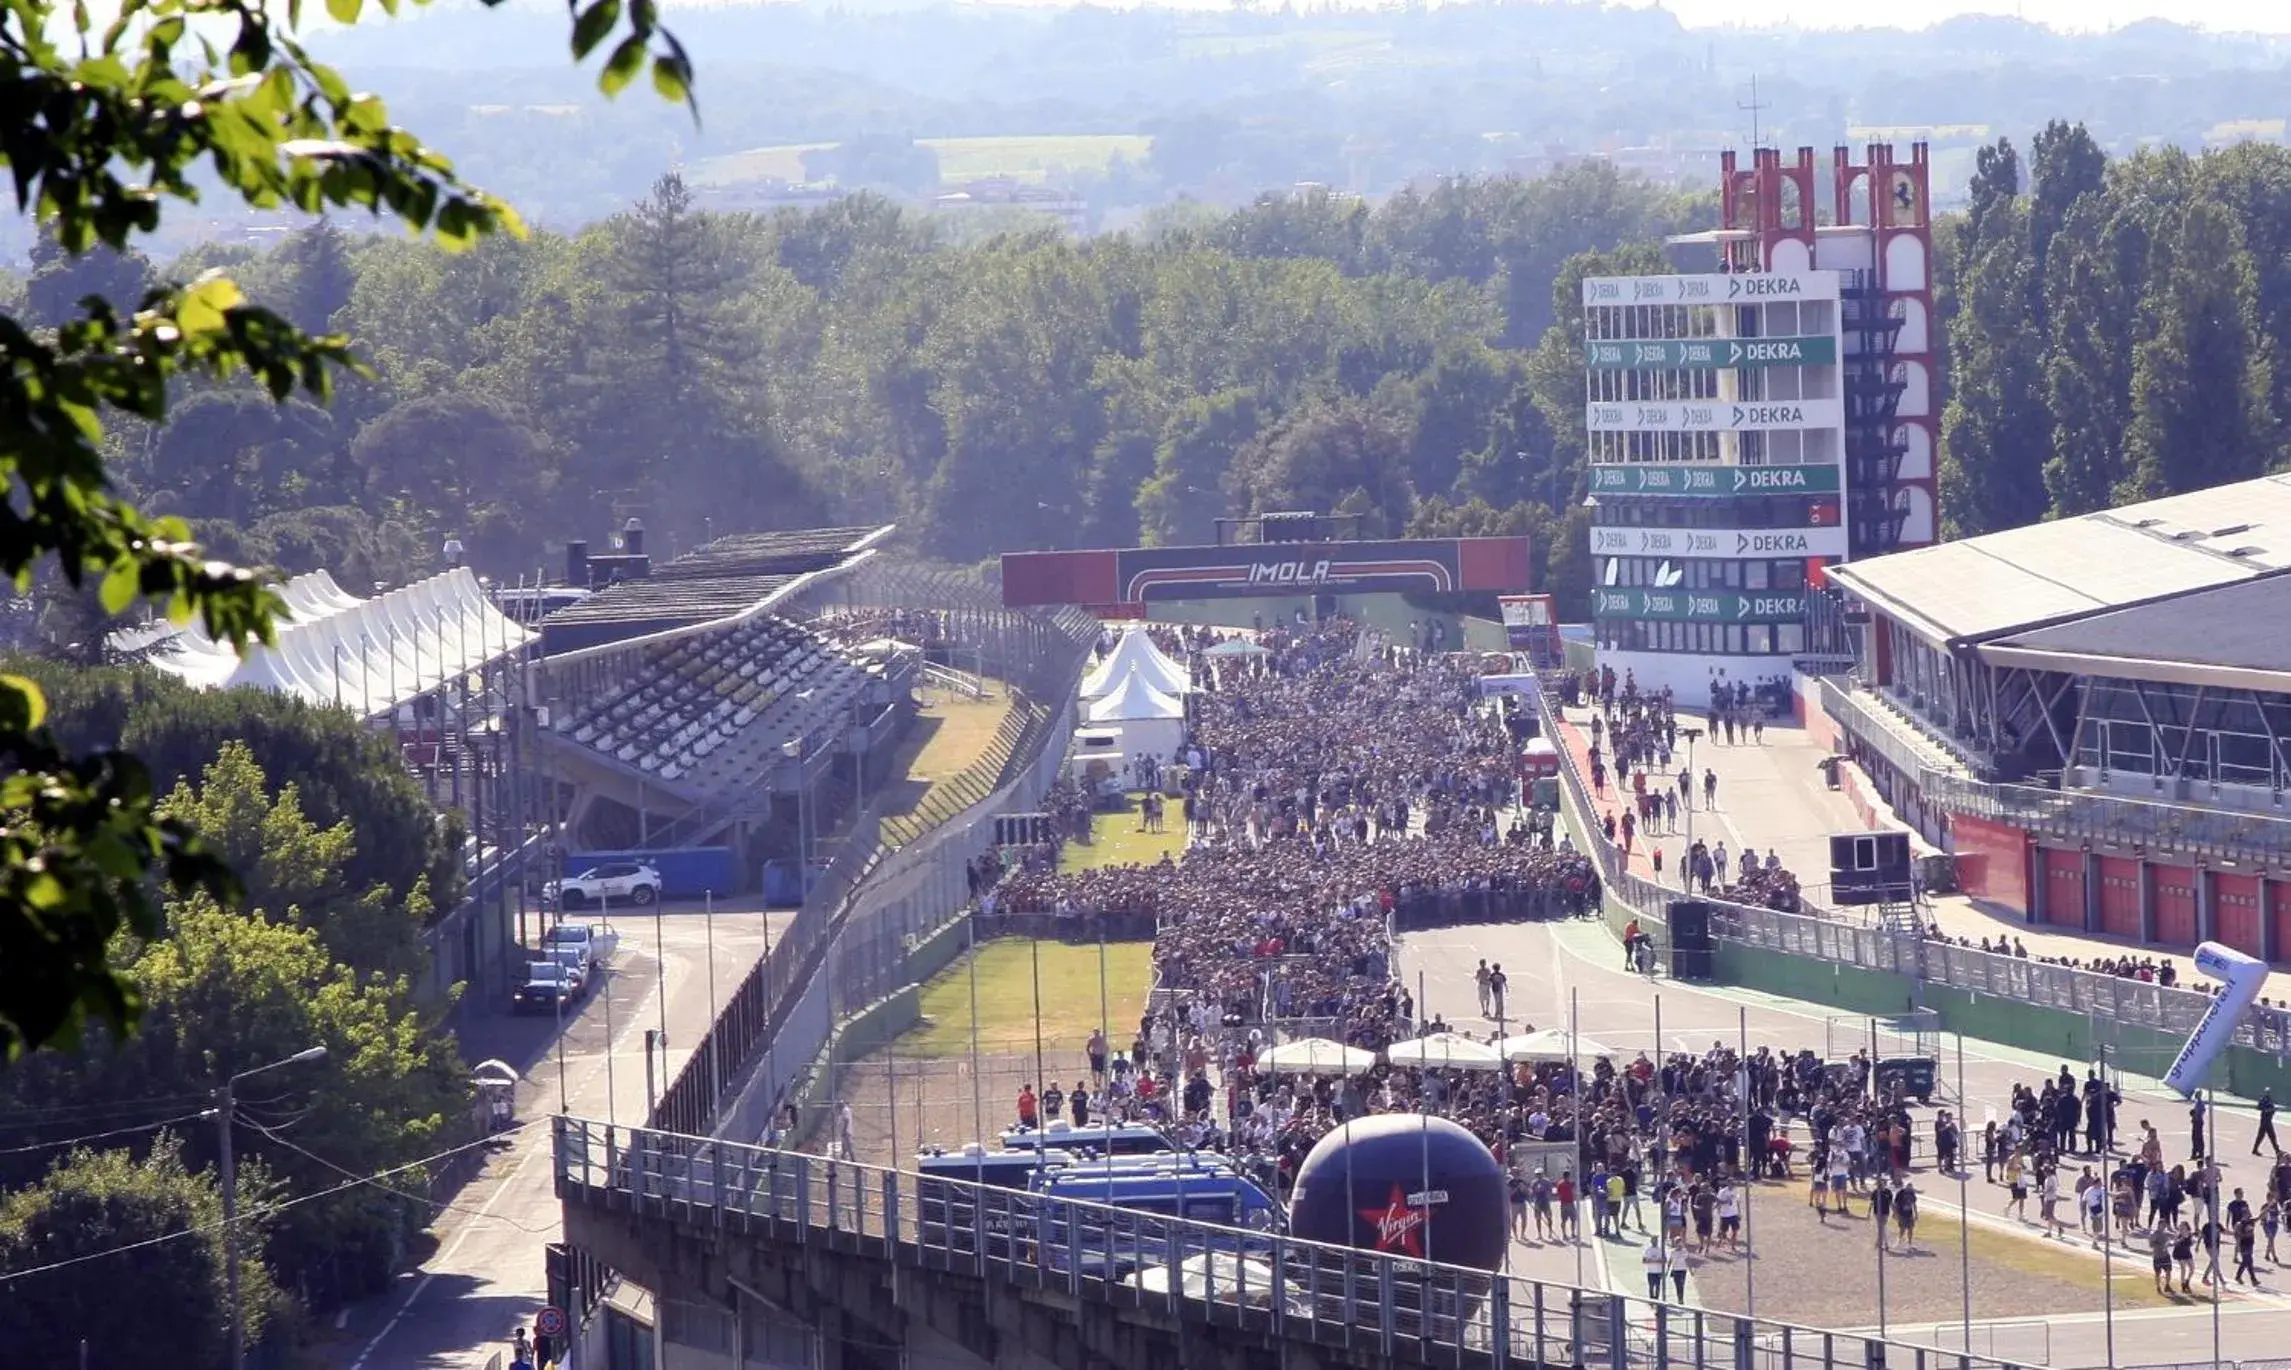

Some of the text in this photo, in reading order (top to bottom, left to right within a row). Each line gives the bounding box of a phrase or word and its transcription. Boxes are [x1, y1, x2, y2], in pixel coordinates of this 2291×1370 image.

[1746, 278, 1801, 295] DEKRA
[1747, 342, 1803, 360] DEKRA
[1749, 407, 1804, 423] DEKRA
[1750, 470, 1806, 487] DEKRA
[1754, 535, 1808, 551] DEKRA
[1248, 559, 1331, 582] IMOLA
[1755, 597, 1810, 615] DEKRA
[1377, 1202, 1422, 1246] Virgin
